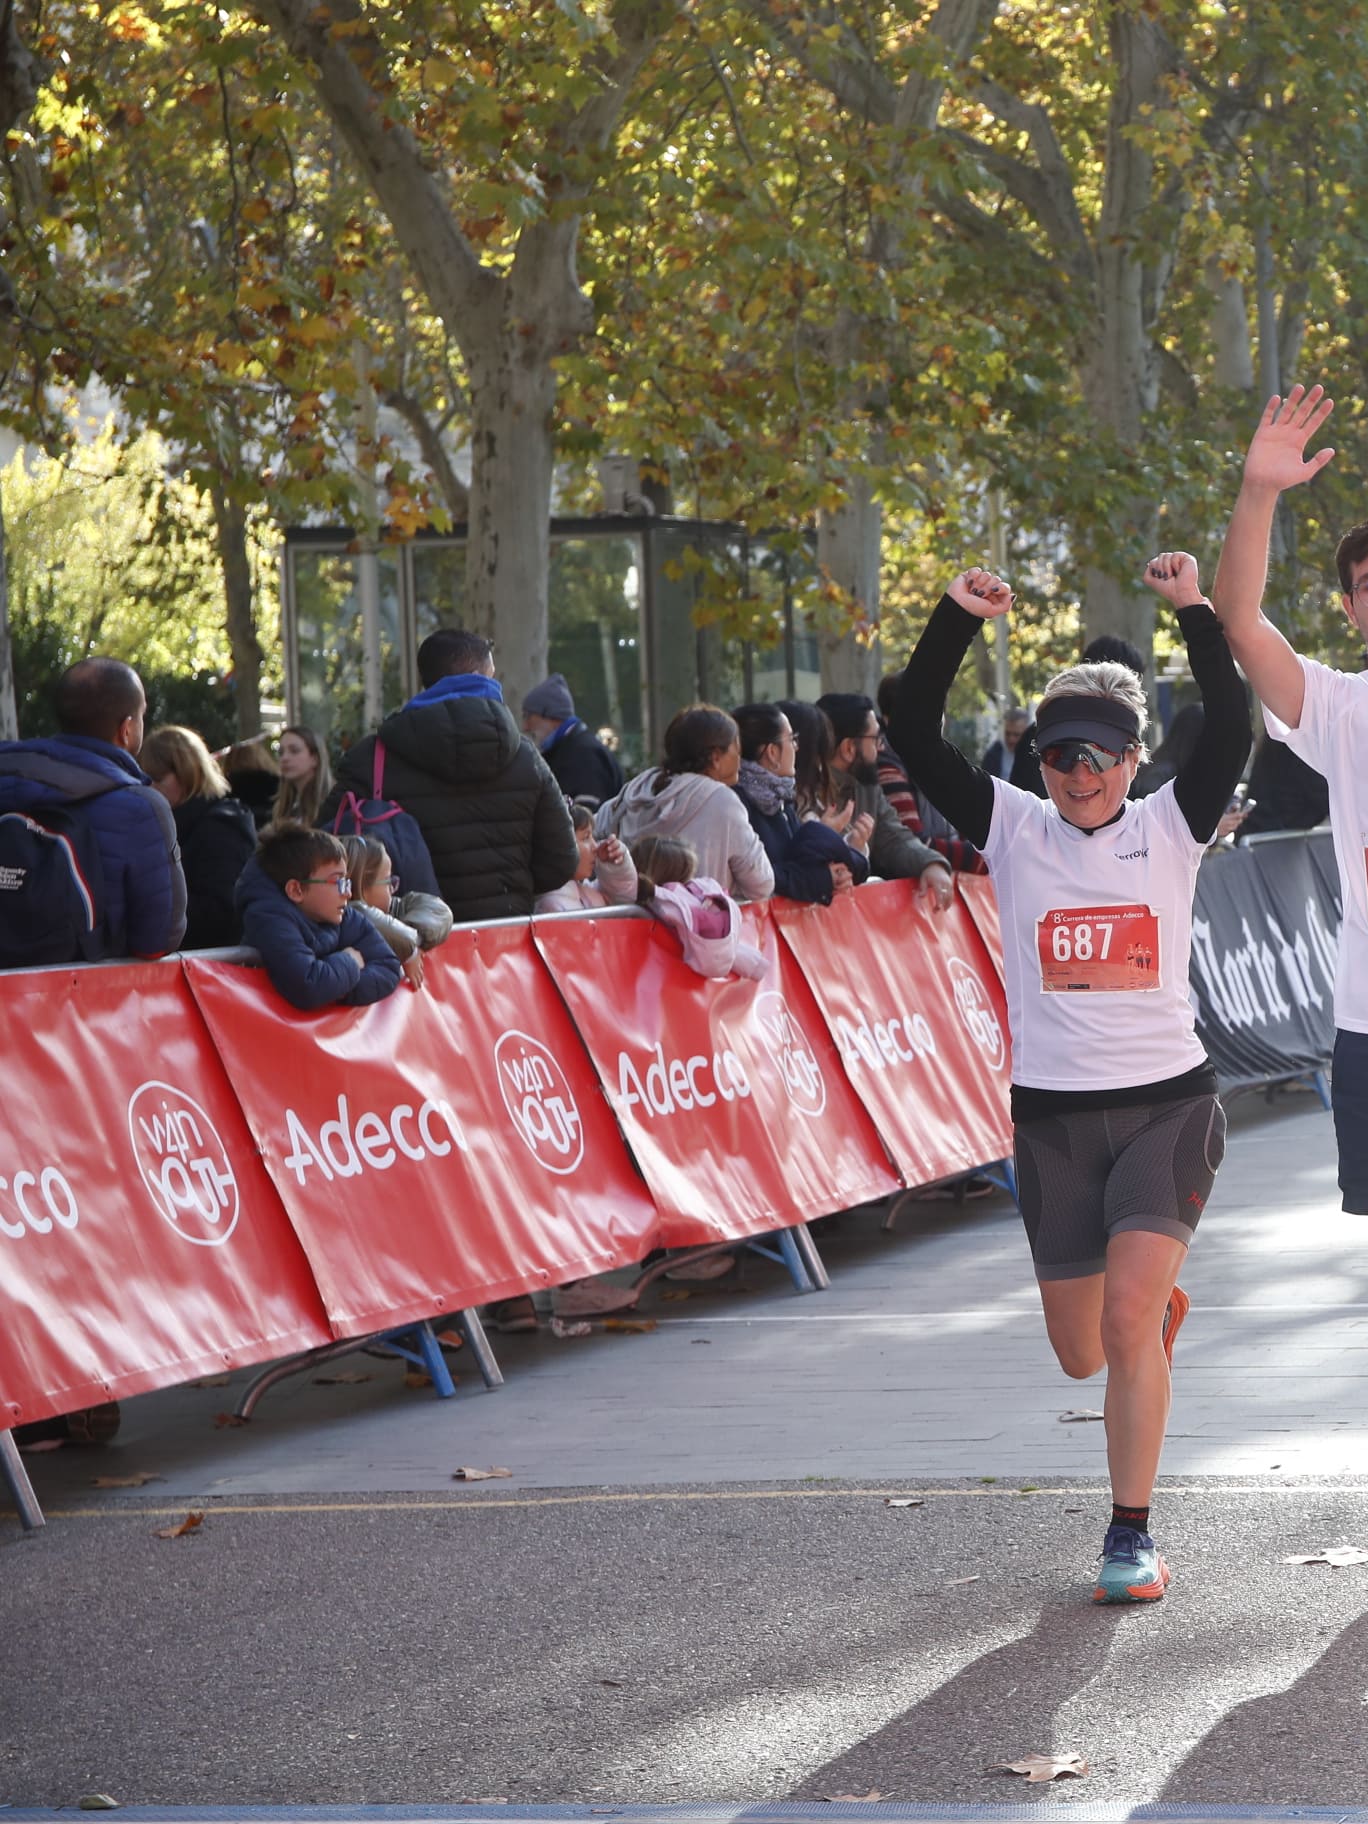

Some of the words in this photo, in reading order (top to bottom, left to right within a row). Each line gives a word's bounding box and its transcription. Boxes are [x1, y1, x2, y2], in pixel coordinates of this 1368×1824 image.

[1052, 923, 1114, 962] 687
[837, 1008, 936, 1074] Adecco
[617, 1041, 750, 1119] Adecco
